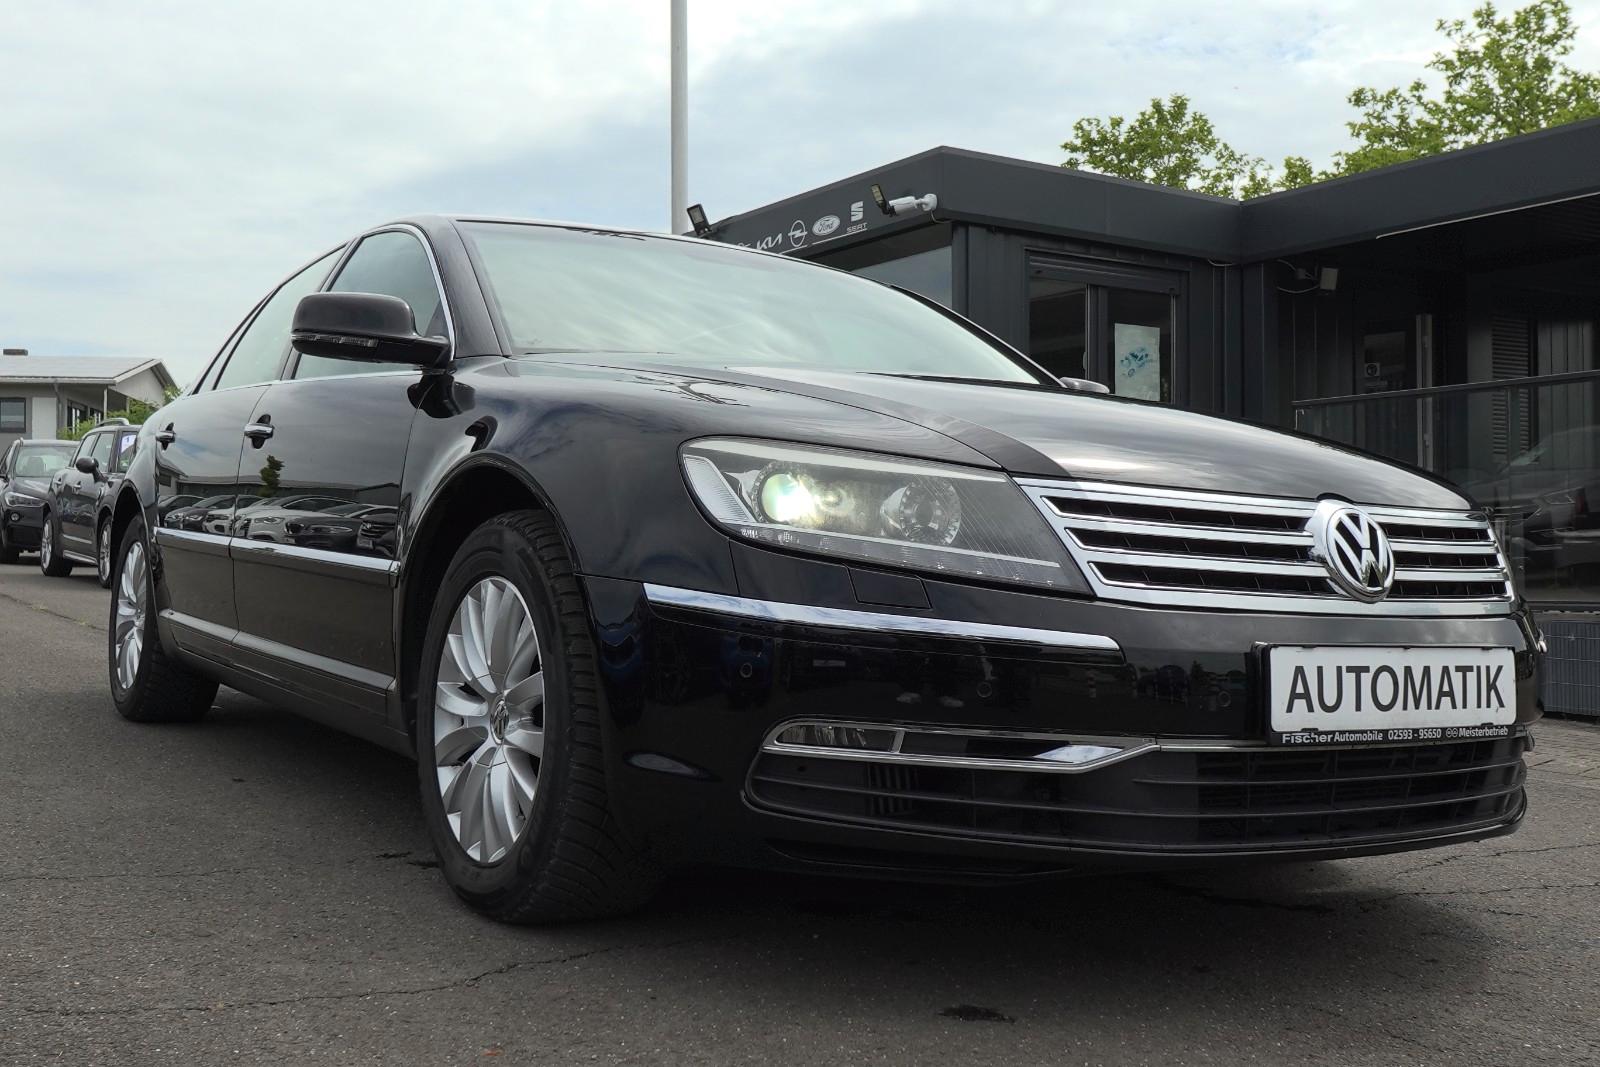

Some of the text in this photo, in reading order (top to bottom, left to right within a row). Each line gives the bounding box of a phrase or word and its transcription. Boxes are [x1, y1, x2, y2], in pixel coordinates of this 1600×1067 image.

[1285, 664, 1505, 714] AUTOMATIK
[1282, 732, 1333, 744] Fischer
[1334, 731, 1383, 742] Automobile
[1388, 729, 1413, 740] 02593
[1419, 728, 1442, 739] 95650
[1459, 726, 1508, 737] Meisterbetrieb
